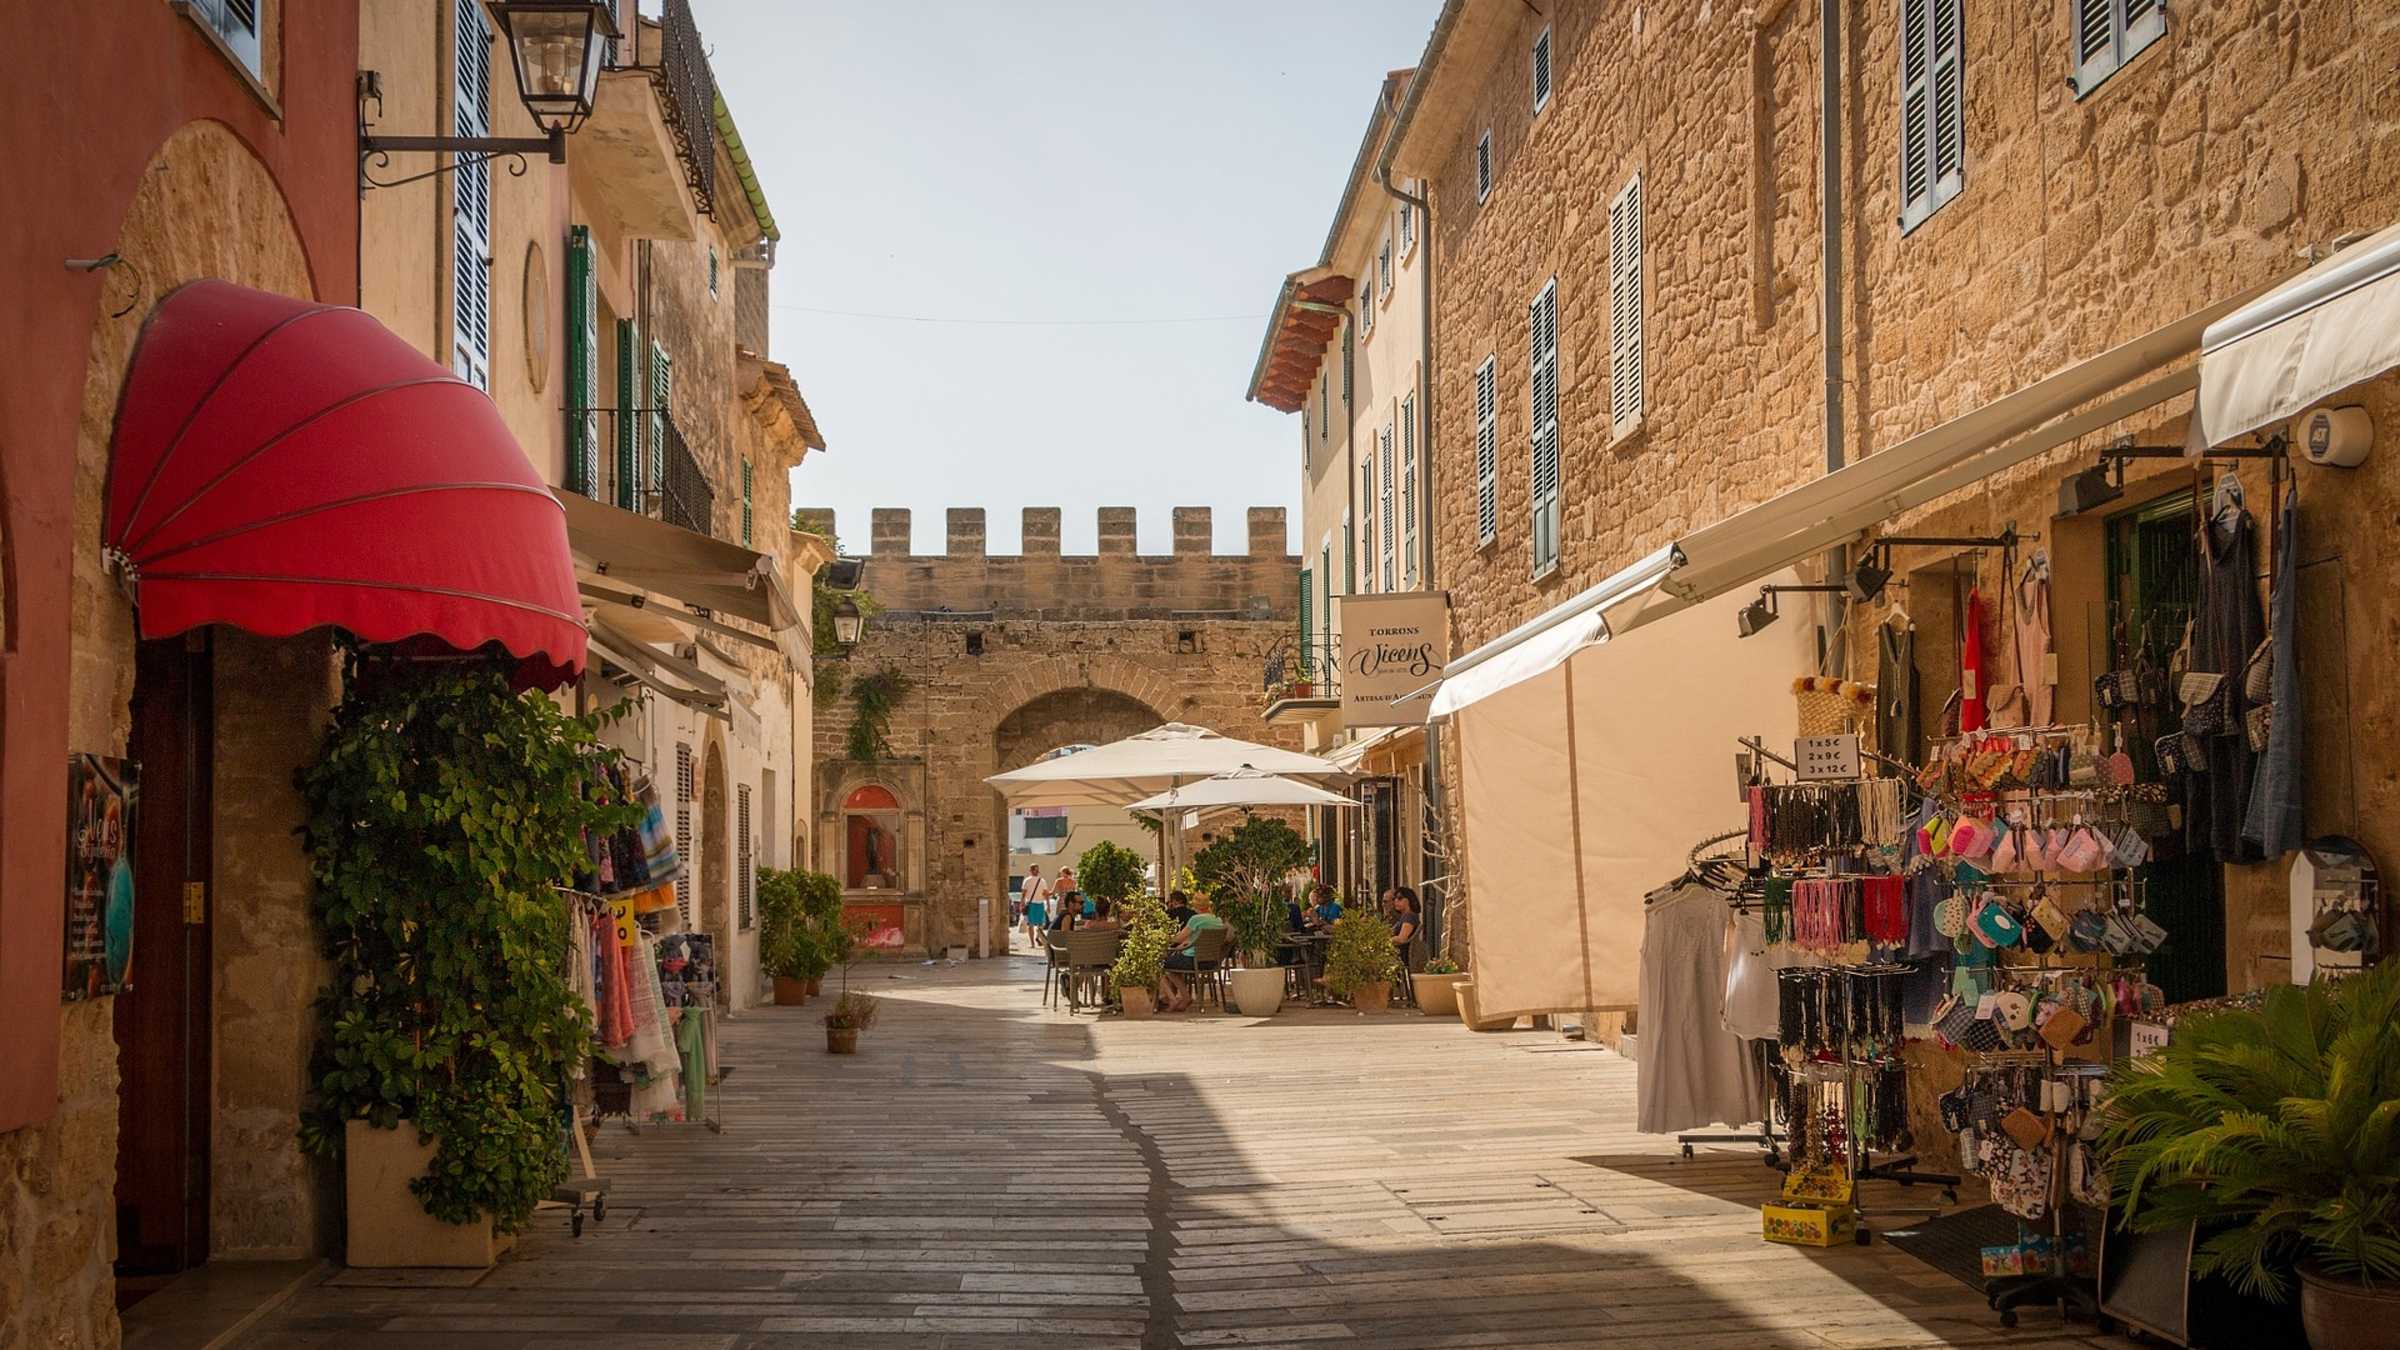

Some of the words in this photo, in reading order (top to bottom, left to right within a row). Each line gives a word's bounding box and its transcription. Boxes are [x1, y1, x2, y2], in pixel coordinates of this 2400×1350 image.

[1369, 626, 1420, 637] TORRONS
[1348, 642, 1441, 677] Vicens
[1808, 740, 1814, 748] 1
[1809, 753, 1815, 761] 2
[1809, 765, 1815, 774] 3
